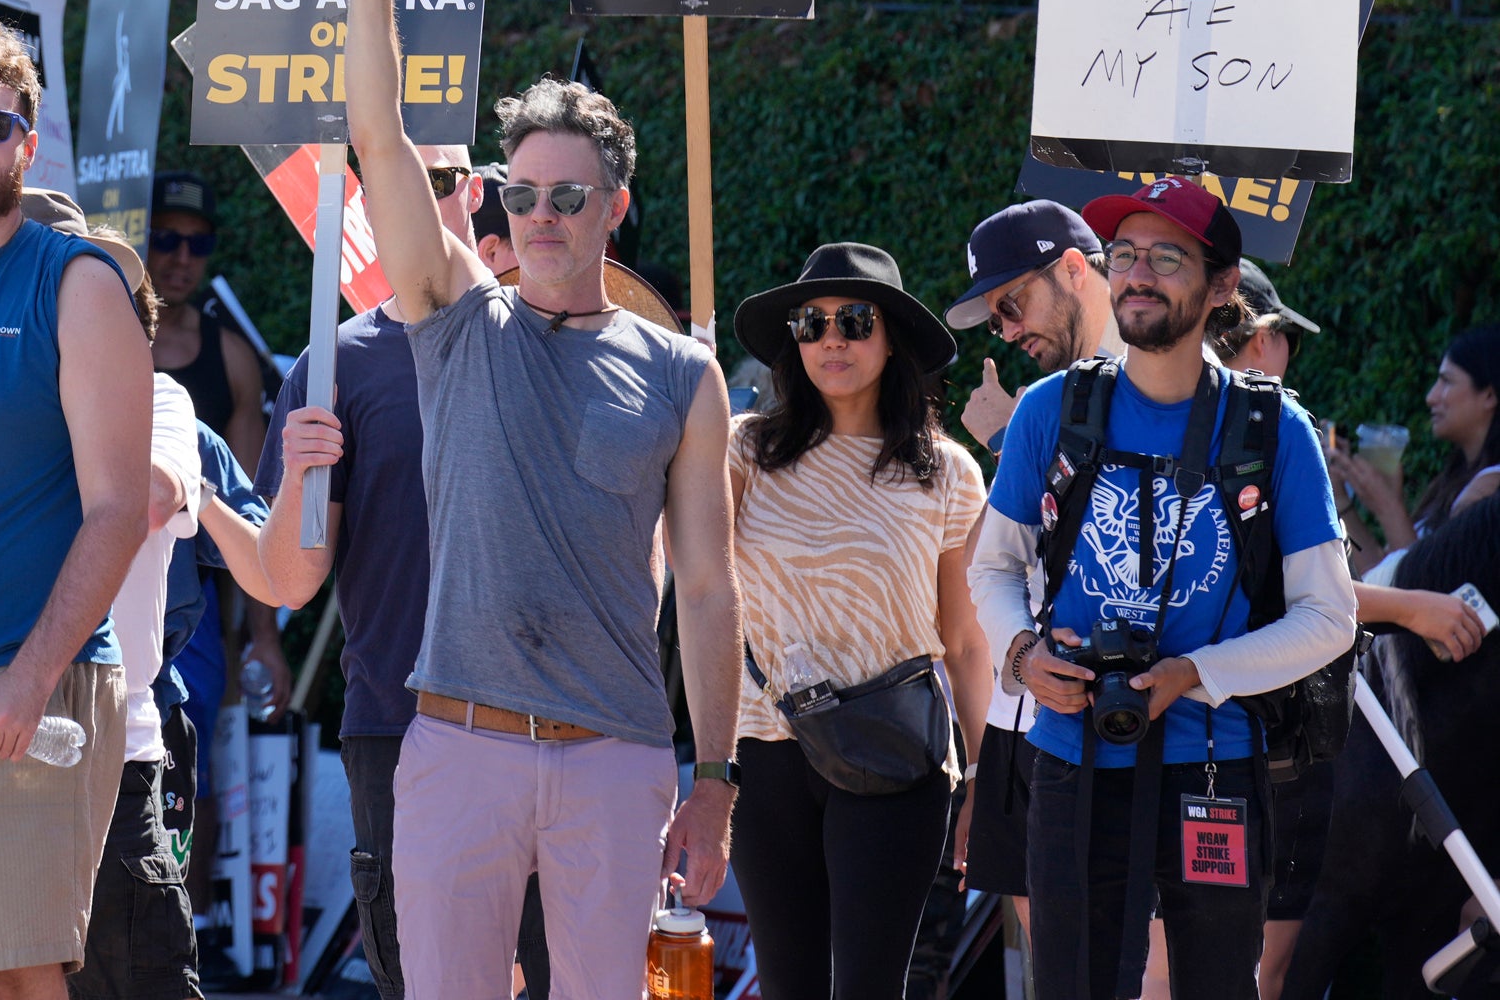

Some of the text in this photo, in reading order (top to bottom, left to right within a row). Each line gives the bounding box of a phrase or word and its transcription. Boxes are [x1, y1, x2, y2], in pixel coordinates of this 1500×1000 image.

[206, 53, 466, 105] STRIE!
[1080, 48, 1293, 99] MY SON
[1196, 507, 1231, 593] AMERICA
[1115, 607, 1147, 621] WEST
[1102, 653, 1125, 661] Canon
[1187, 805, 1238, 821] WGA STRIKE
[1196, 831, 1229, 846] WGAW
[1196, 845, 1231, 861] STRIKE
[1191, 860, 1237, 876] SUPPORT
